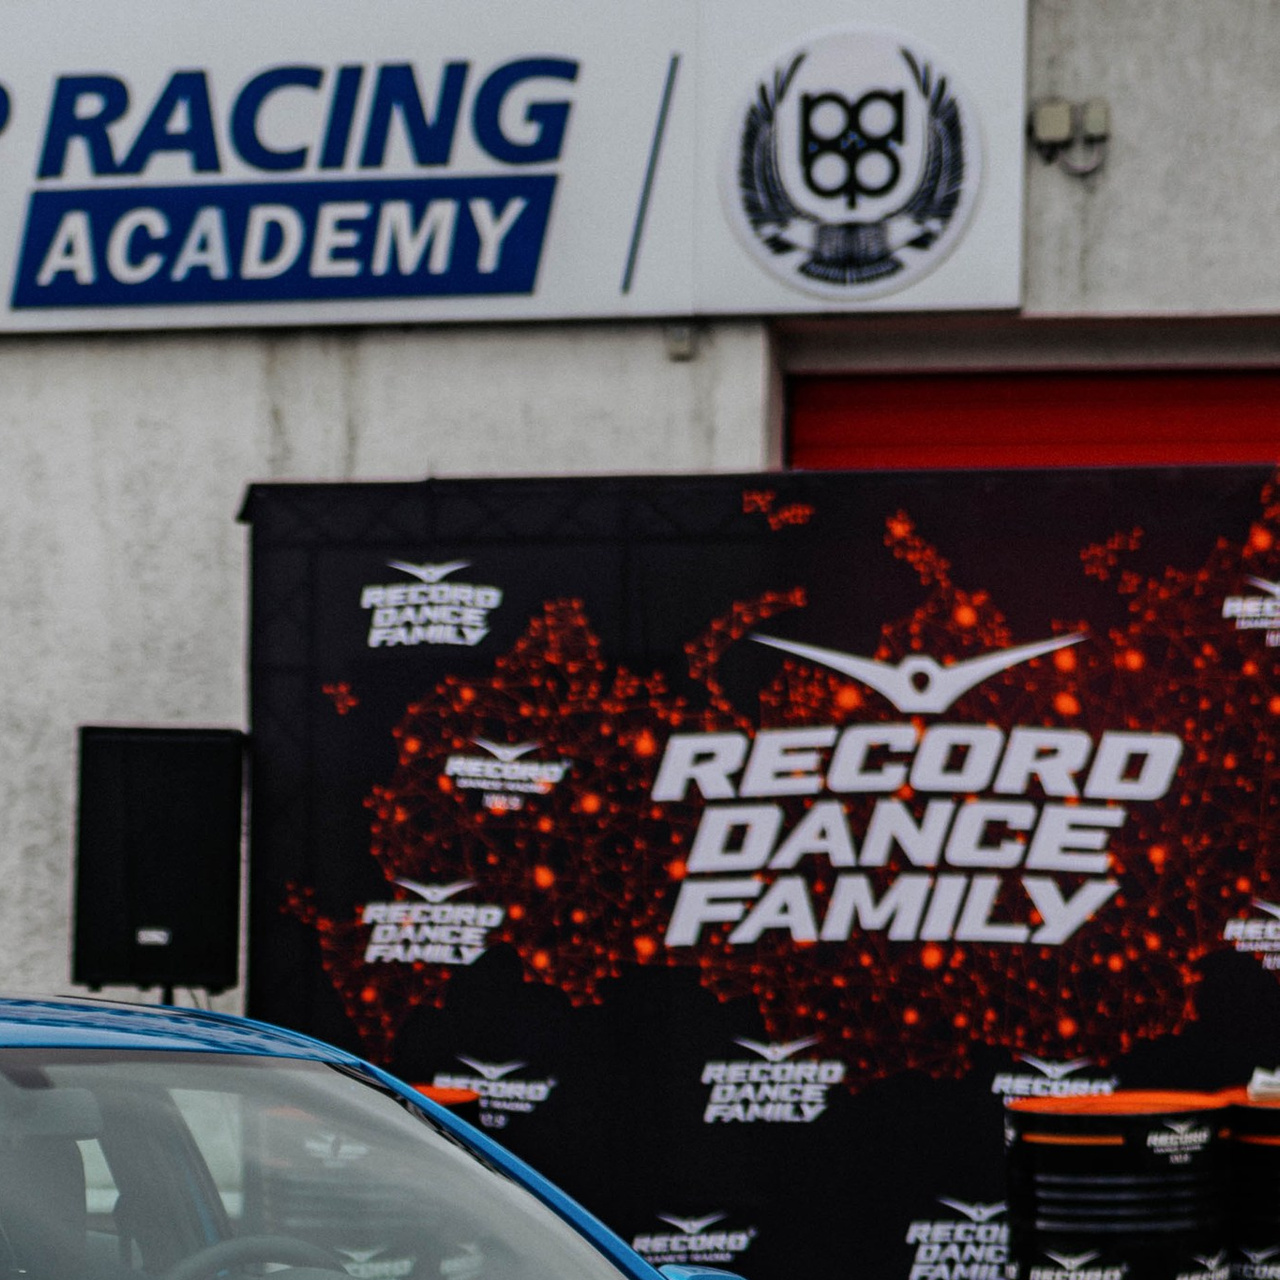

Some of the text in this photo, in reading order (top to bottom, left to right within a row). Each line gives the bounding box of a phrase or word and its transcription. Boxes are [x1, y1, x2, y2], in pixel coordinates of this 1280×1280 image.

[36, 57, 581, 179] RACING
[37, 198, 526, 288] ACADEMY
[360, 582, 503, 609] RECORD
[372, 606, 490, 628] DANCE
[367, 625, 490, 647] FAMILY
[444, 755, 568, 783] RECORD
[650, 723, 1184, 801] RECORD
[685, 798, 1127, 873] DANCE
[362, 903, 506, 928] RECORD
[664, 872, 1122, 947] FAMILY
[370, 924, 489, 946] DANCE
[364, 944, 487, 965] FAMILY
[701, 1060, 847, 1084] RECORD
[710, 1082, 830, 1103] DANCE
[703, 1102, 828, 1123] FAMILY
[631, 1235, 750, 1252] RECORD
[915, 1242, 1009, 1264] DANC
